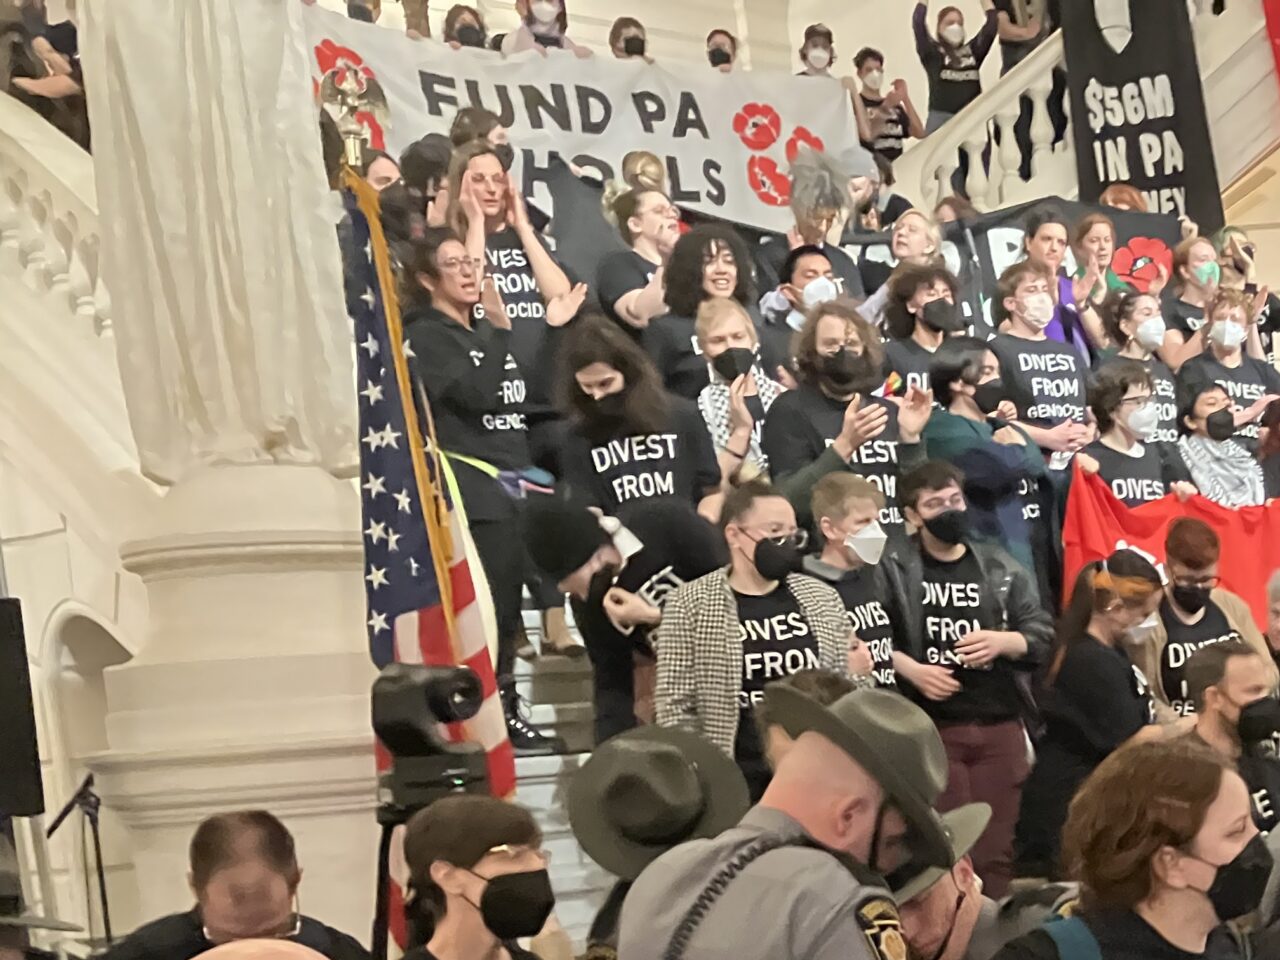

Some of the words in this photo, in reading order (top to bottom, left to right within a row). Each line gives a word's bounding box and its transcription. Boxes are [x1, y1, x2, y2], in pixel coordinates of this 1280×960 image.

[418, 69, 613, 135] FUND
[631, 90, 710, 139] PA
[1084, 74, 1175, 134] $56M
[1093, 136, 1130, 182] IN
[1138, 130, 1184, 177] PA
[1018, 353, 1076, 373] DIVEST
[1031, 377, 1079, 397] FROM
[591, 434, 678, 473] DIVEST
[612, 471, 674, 503] FROM
[1112, 478, 1164, 501] DIVES
[921, 581, 980, 607] DIVES
[847, 601, 890, 632] DIVES
[926, 616, 981, 642] FRO
